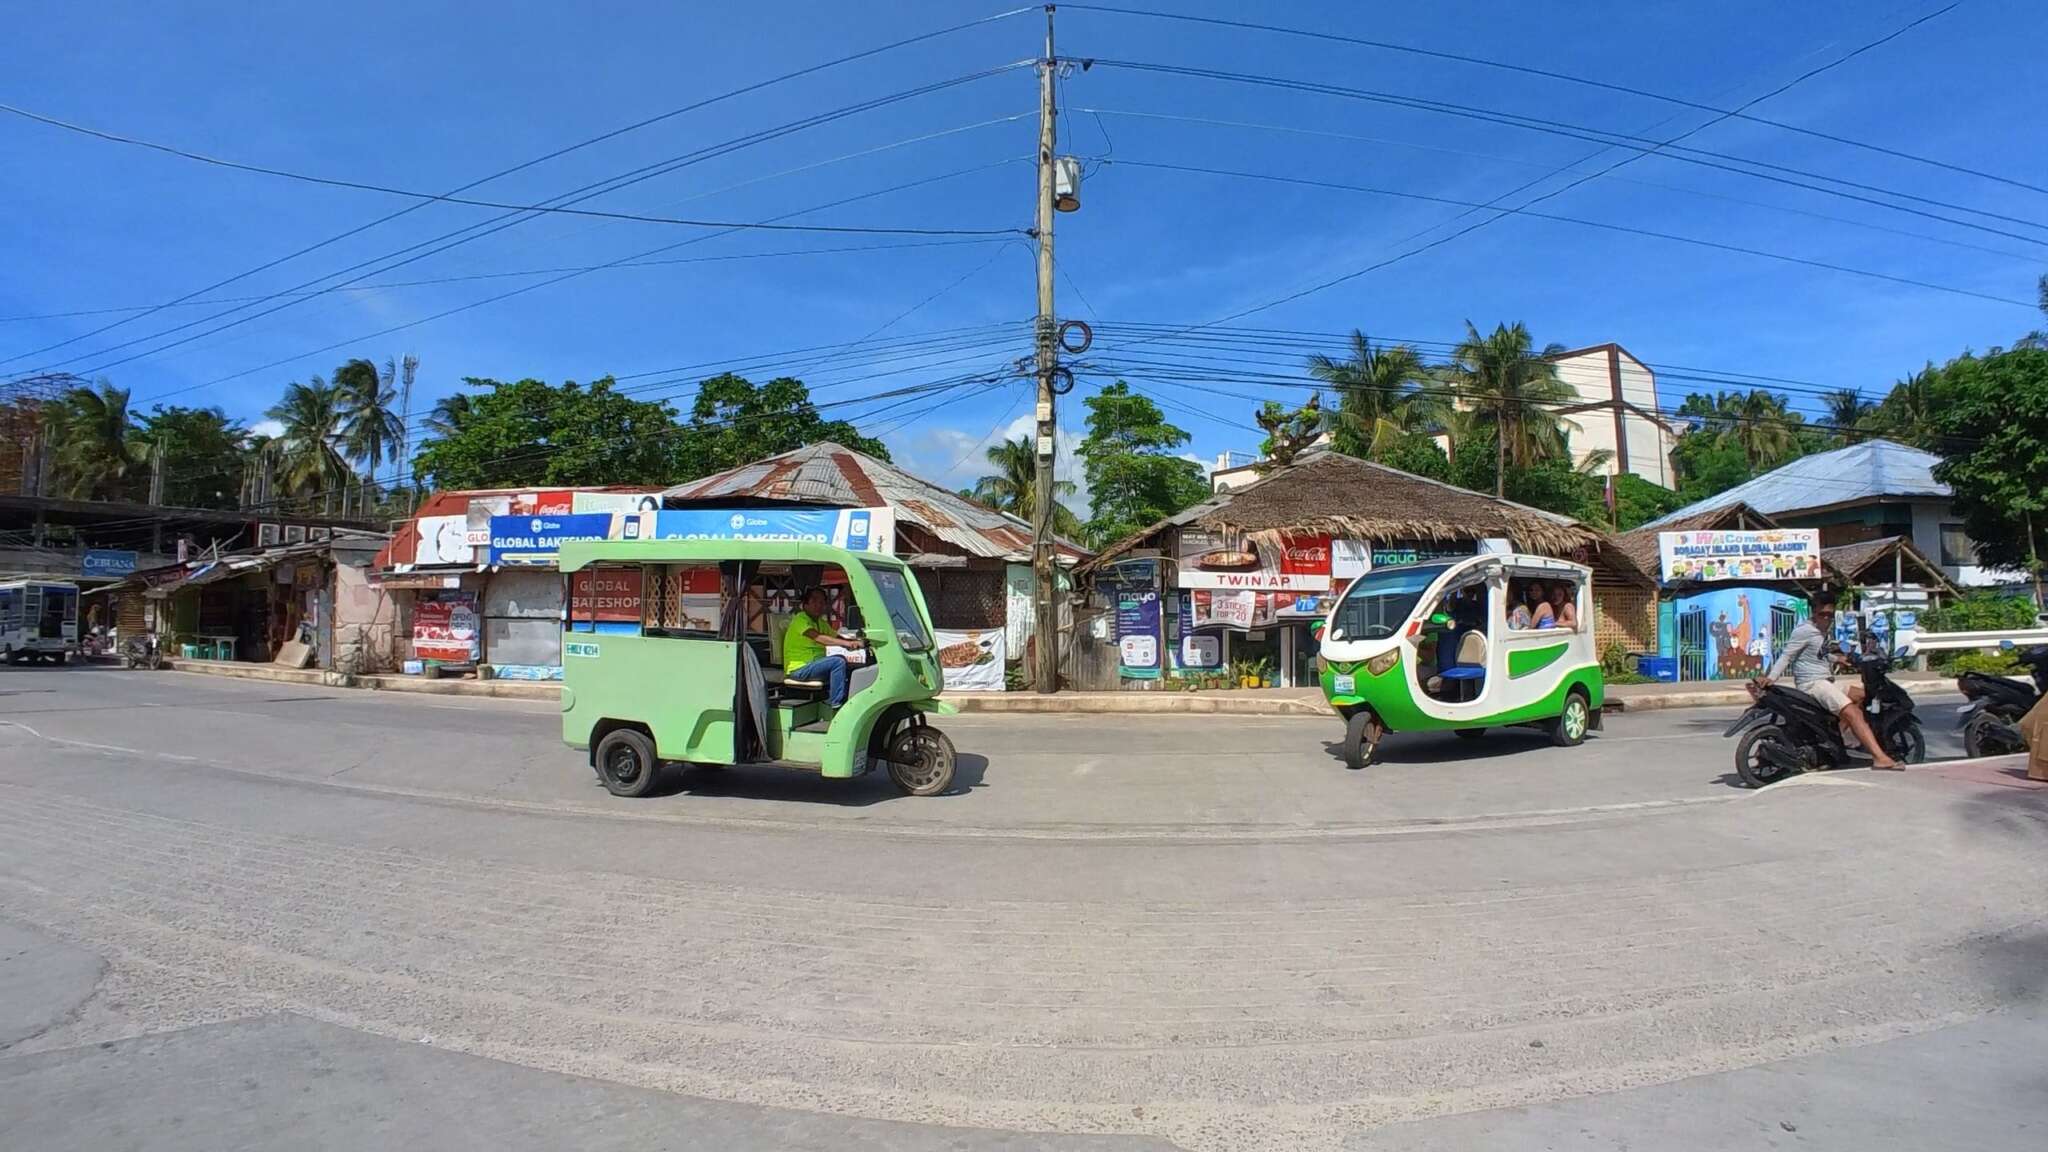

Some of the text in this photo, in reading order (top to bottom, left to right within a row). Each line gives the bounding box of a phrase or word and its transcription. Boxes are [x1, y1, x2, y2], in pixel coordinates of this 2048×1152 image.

[744, 517, 768, 526] Globe
[493, 537, 537, 549] GLOBAL
[1285, 546, 1327, 561] Coca-Cola
[579, 580, 631, 592] GLOBAL
[1217, 575, 1291, 586] TWIN AP
[1118, 591, 1156, 604] maya
